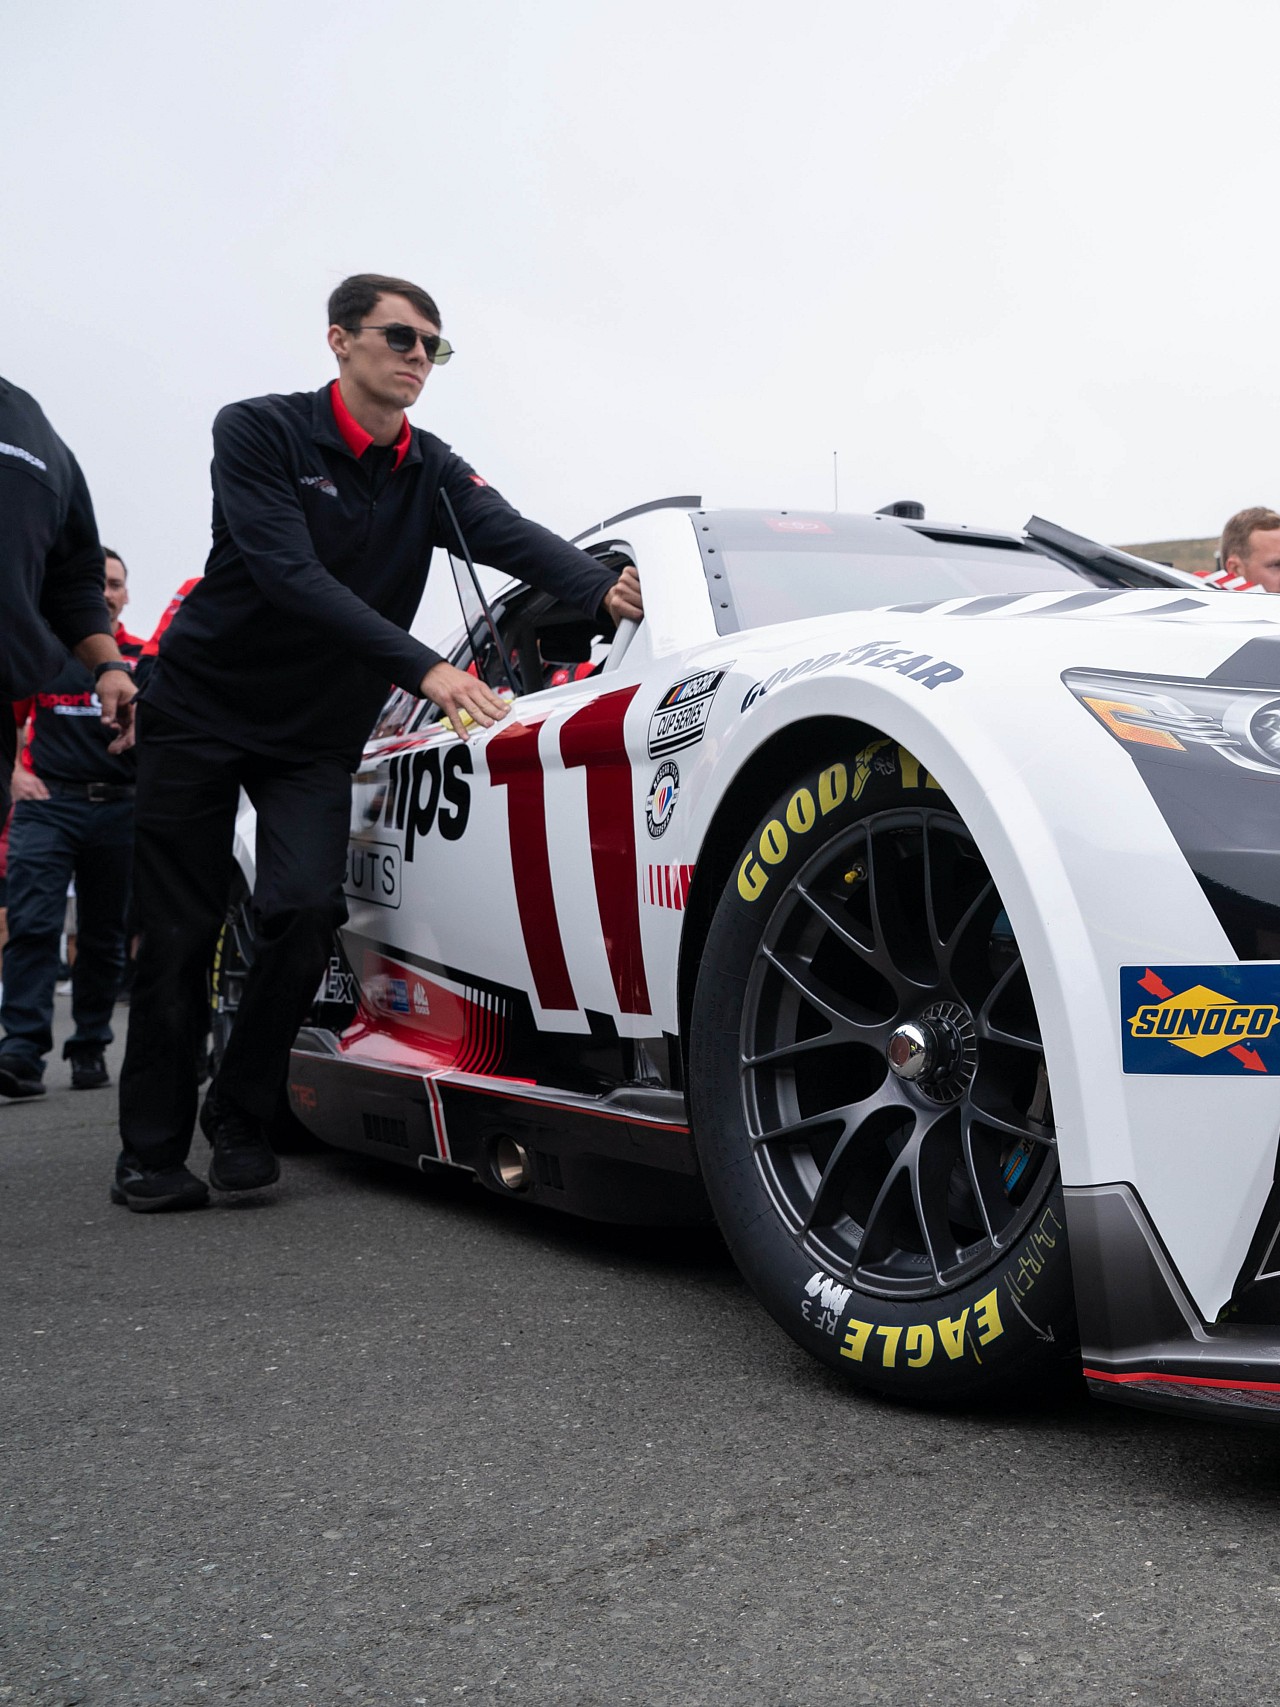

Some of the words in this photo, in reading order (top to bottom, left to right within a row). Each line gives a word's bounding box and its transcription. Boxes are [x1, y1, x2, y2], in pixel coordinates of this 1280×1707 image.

[676, 671, 720, 702] NASCAR
[740, 648, 964, 713] GOODYEAR
[657, 711, 677, 737] CUP
[673, 701, 705, 732] SERIES
[486, 684, 653, 1016] 11
[1135, 1008, 1274, 1036] SUNOCO
[813, 1310, 839, 1336] RF
[840, 1287, 1005, 1369] EAGLE
